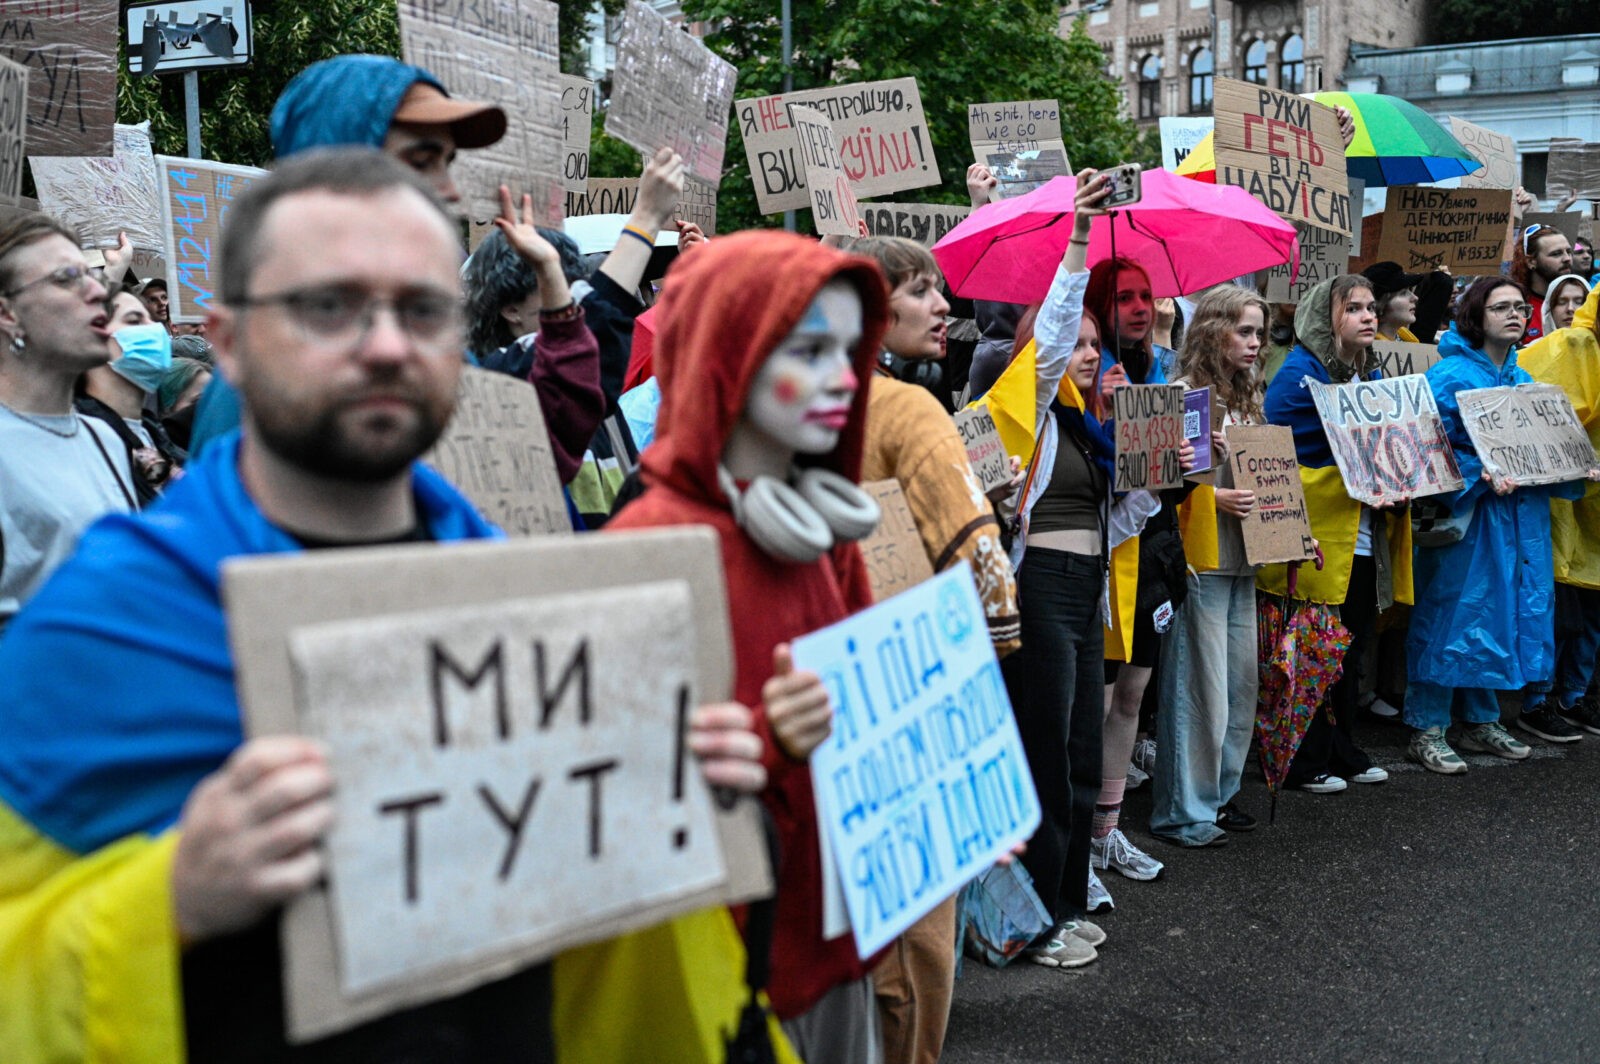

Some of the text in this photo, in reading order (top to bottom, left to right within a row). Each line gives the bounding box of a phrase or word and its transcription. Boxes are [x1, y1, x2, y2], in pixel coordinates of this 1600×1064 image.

[741, 106, 759, 137] Я
[757, 96, 788, 133] НЕ
[971, 106, 989, 125] Ah
[1028, 103, 1057, 121] here
[1259, 89, 1312, 131] РУКИ
[1243, 112, 1325, 166] ГЕТЬ
[758, 147, 805, 195] ВИ
[815, 189, 838, 221] ВИ
[1404, 211, 1509, 228] ДЕМОКРАТИЧНИХ
[1271, 263, 1320, 282] НАОД
[1121, 422, 1142, 452] ЗА
[876, 610, 947, 714] ПІД
[426, 637, 595, 748] МИ
